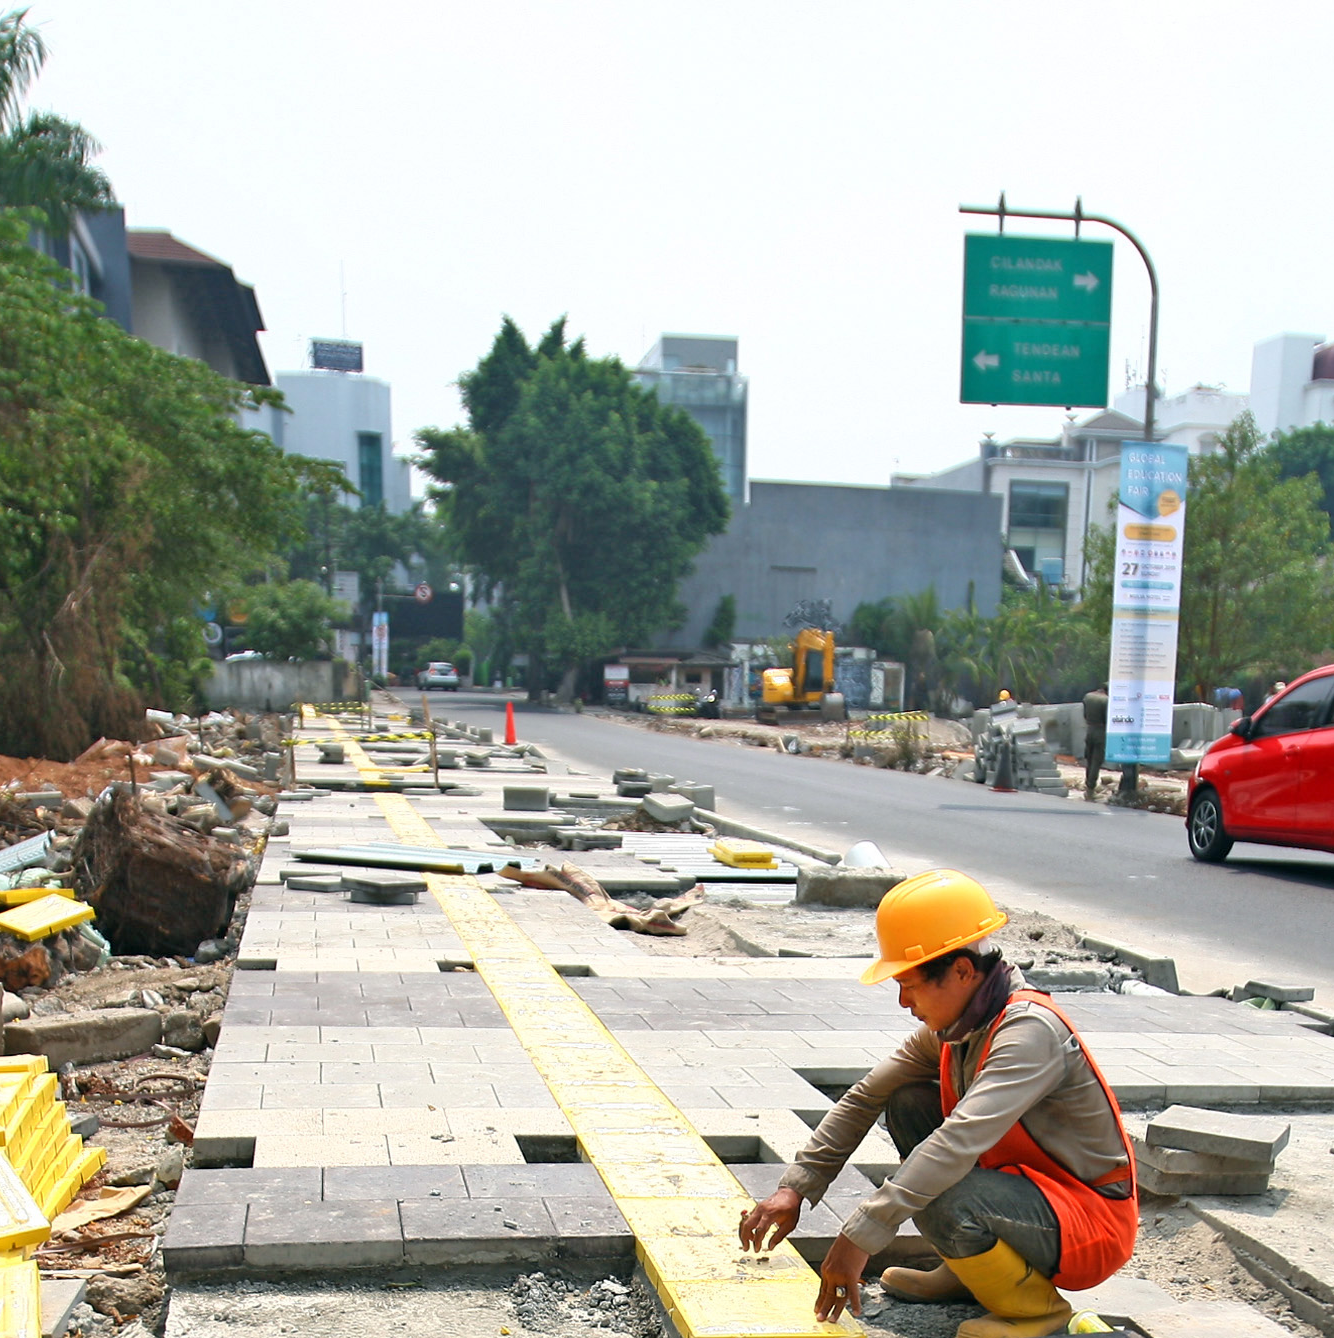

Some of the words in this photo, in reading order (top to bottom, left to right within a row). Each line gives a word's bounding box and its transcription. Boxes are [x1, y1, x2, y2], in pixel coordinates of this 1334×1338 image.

[989, 256, 1063, 272] CILANDAK
[989, 284, 1058, 299] RAGUNAN
[1014, 342, 1080, 358] TENDEAN
[1012, 369, 1061, 384] SANTA
[1128, 452, 1166, 465] GLOBAL
[1127, 469, 1183, 483] EDUCATION
[1127, 485, 1149, 497] FAIR
[1122, 562, 1139, 576] 27
